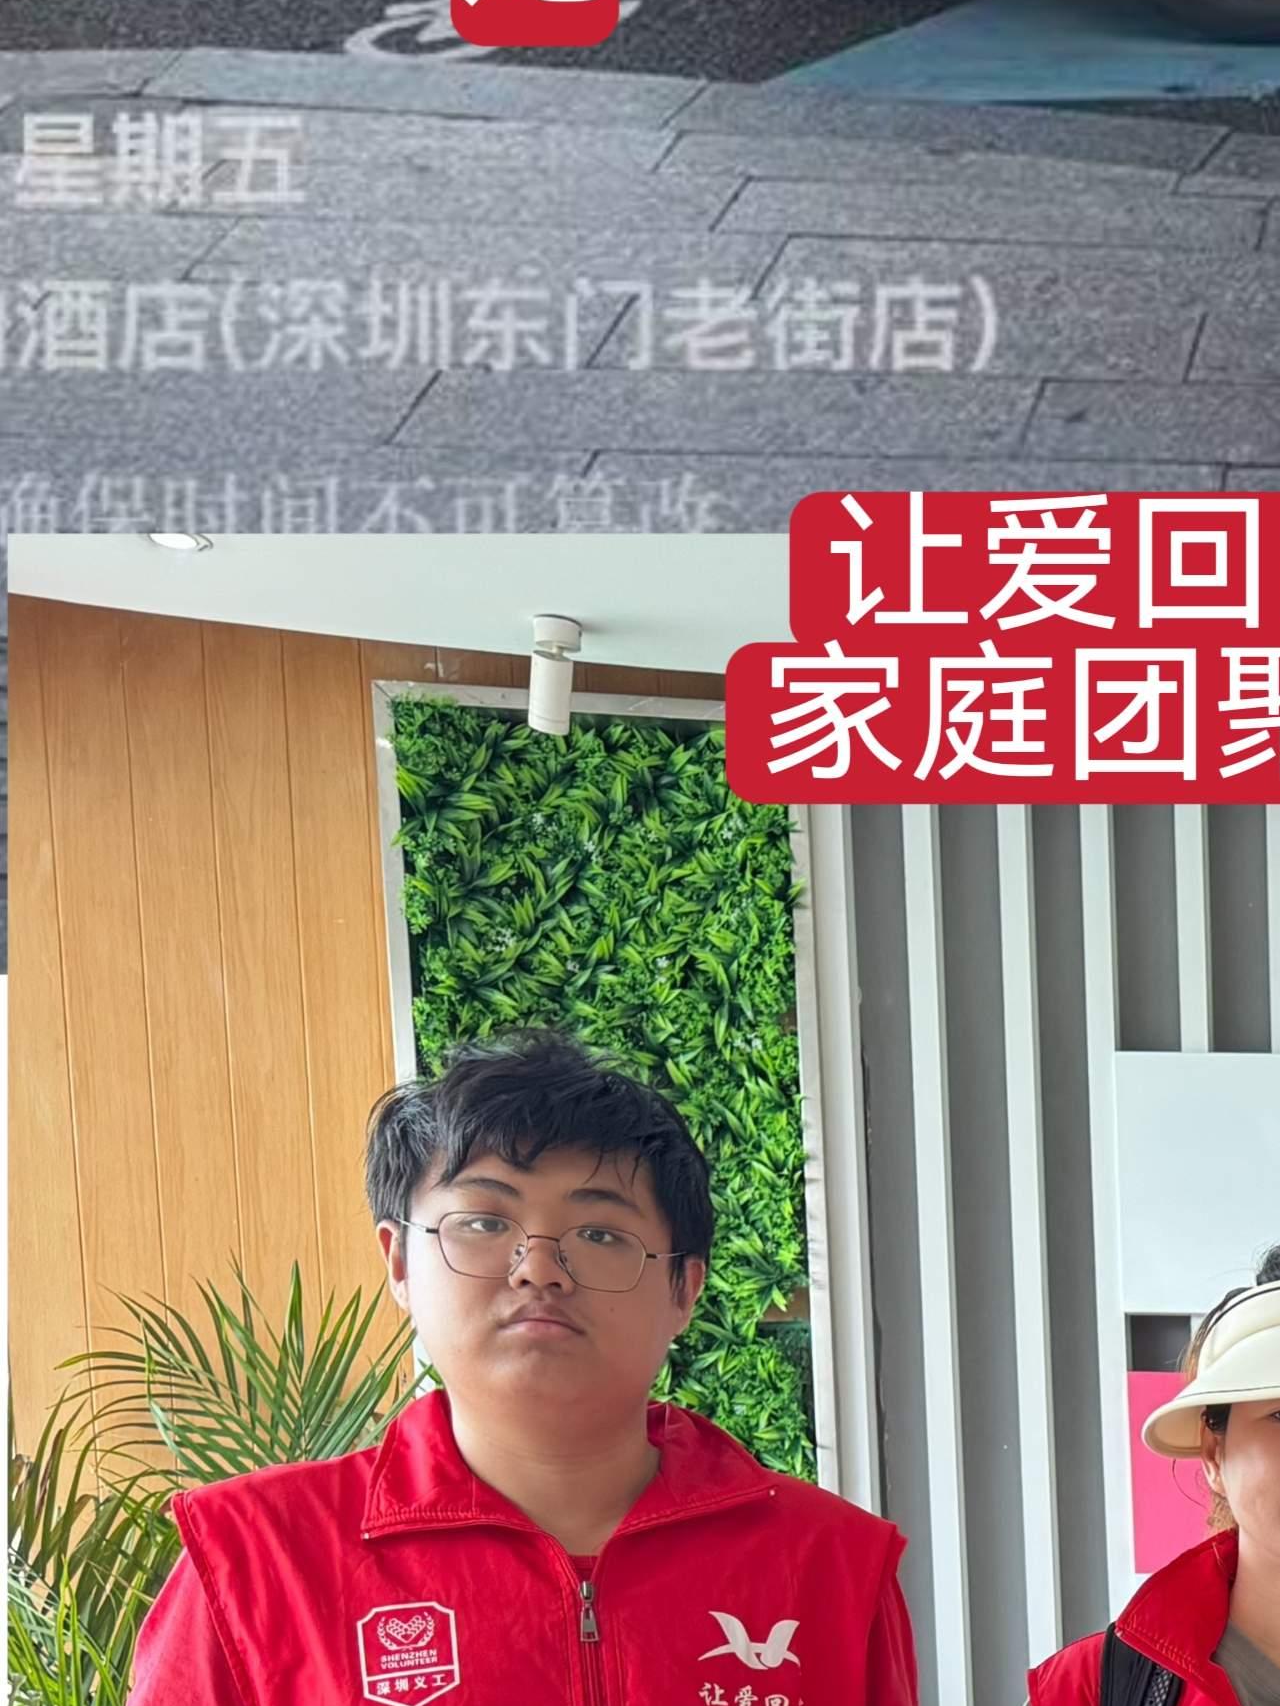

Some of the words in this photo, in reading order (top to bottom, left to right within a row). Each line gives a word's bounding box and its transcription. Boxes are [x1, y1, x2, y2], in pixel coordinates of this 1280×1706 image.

[381, 1649, 437, 1663] SHENZHEN
[381, 1656, 438, 1669] VOLUNTEER
[376, 1673, 447, 1696] 深圳义工
